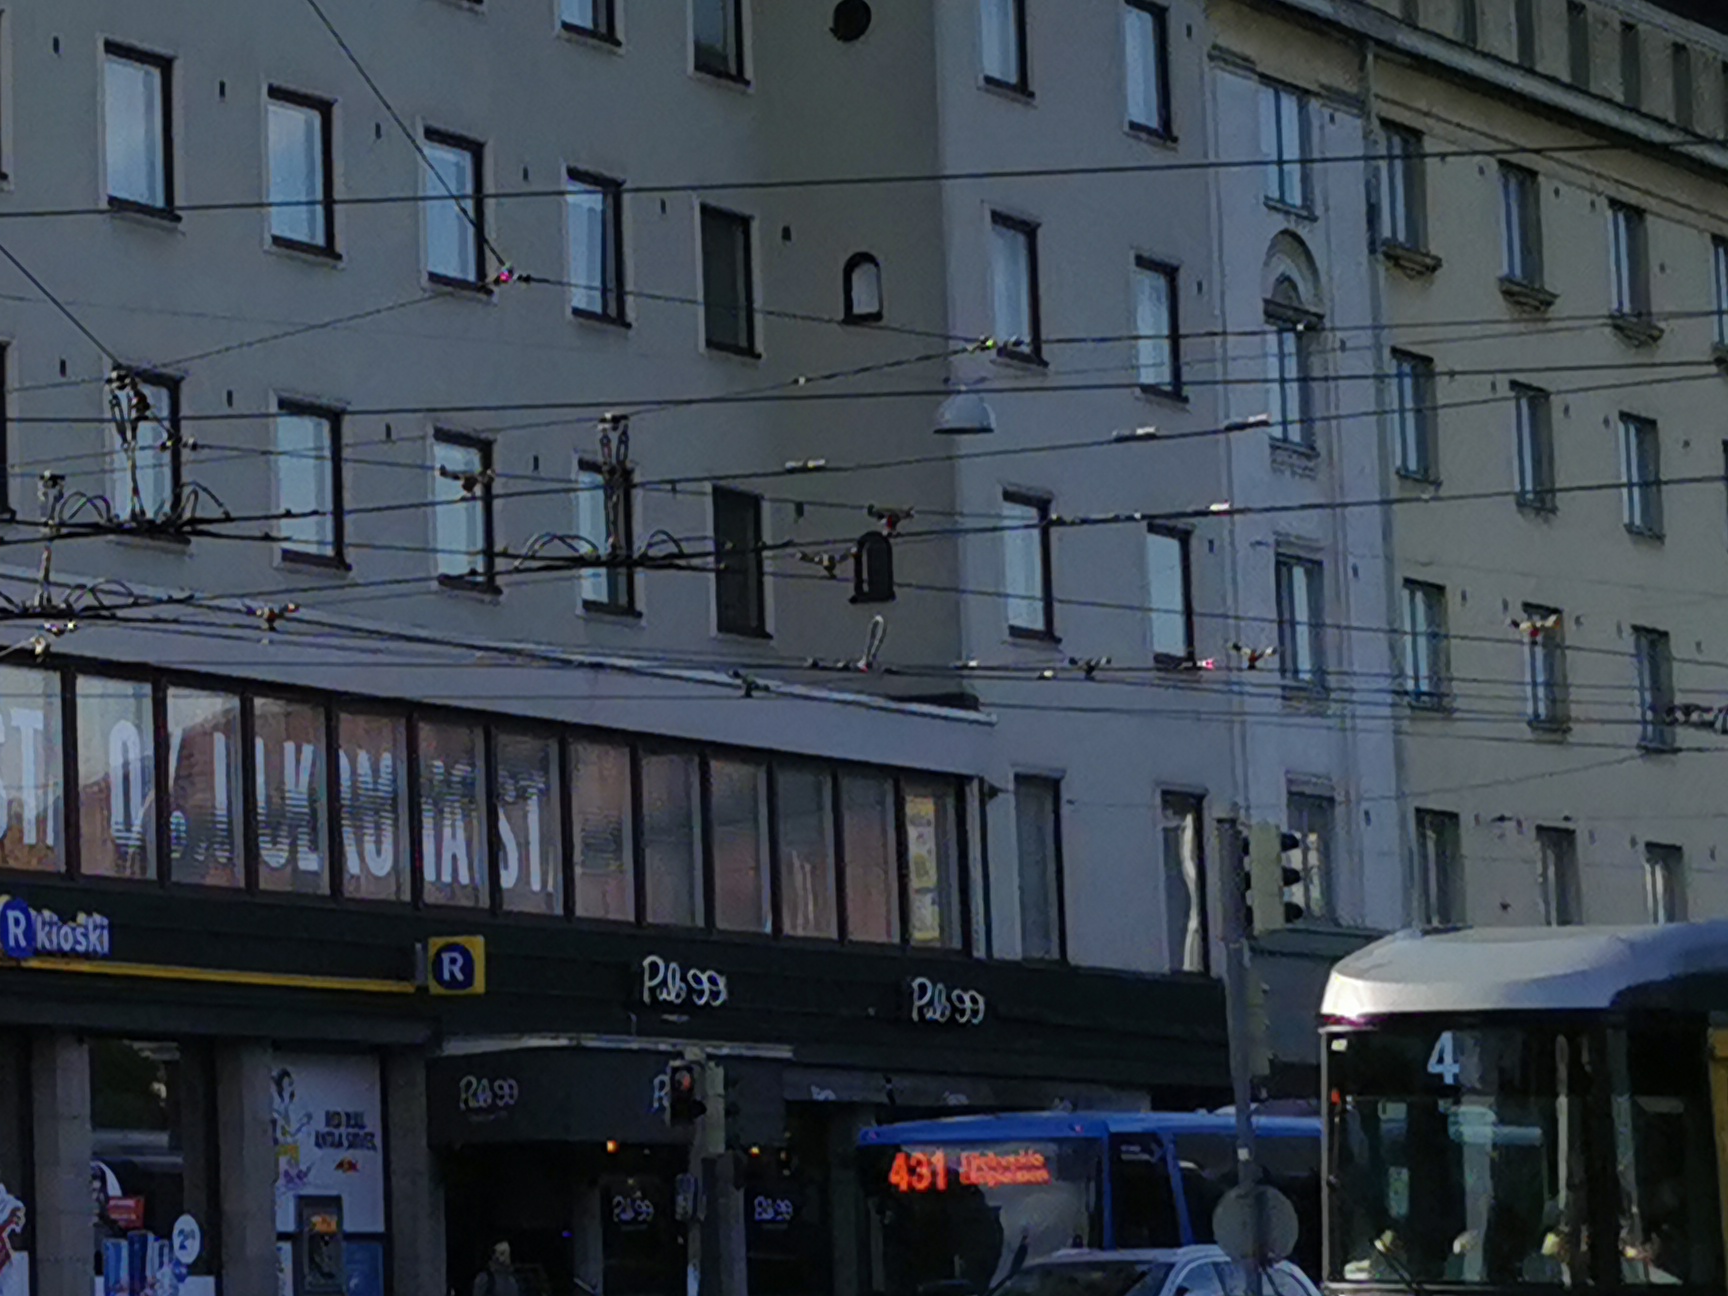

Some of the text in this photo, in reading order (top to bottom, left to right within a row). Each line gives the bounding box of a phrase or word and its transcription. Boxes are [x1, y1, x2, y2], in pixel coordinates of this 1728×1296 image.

[6, 909, 109, 952] R kioski
[442, 951, 465, 982] R
[642, 954, 728, 1007] Pub 99
[910, 977, 985, 1025] Pub 99
[1427, 1030, 1460, 1085] 4
[889, 1150, 948, 1193] 431
